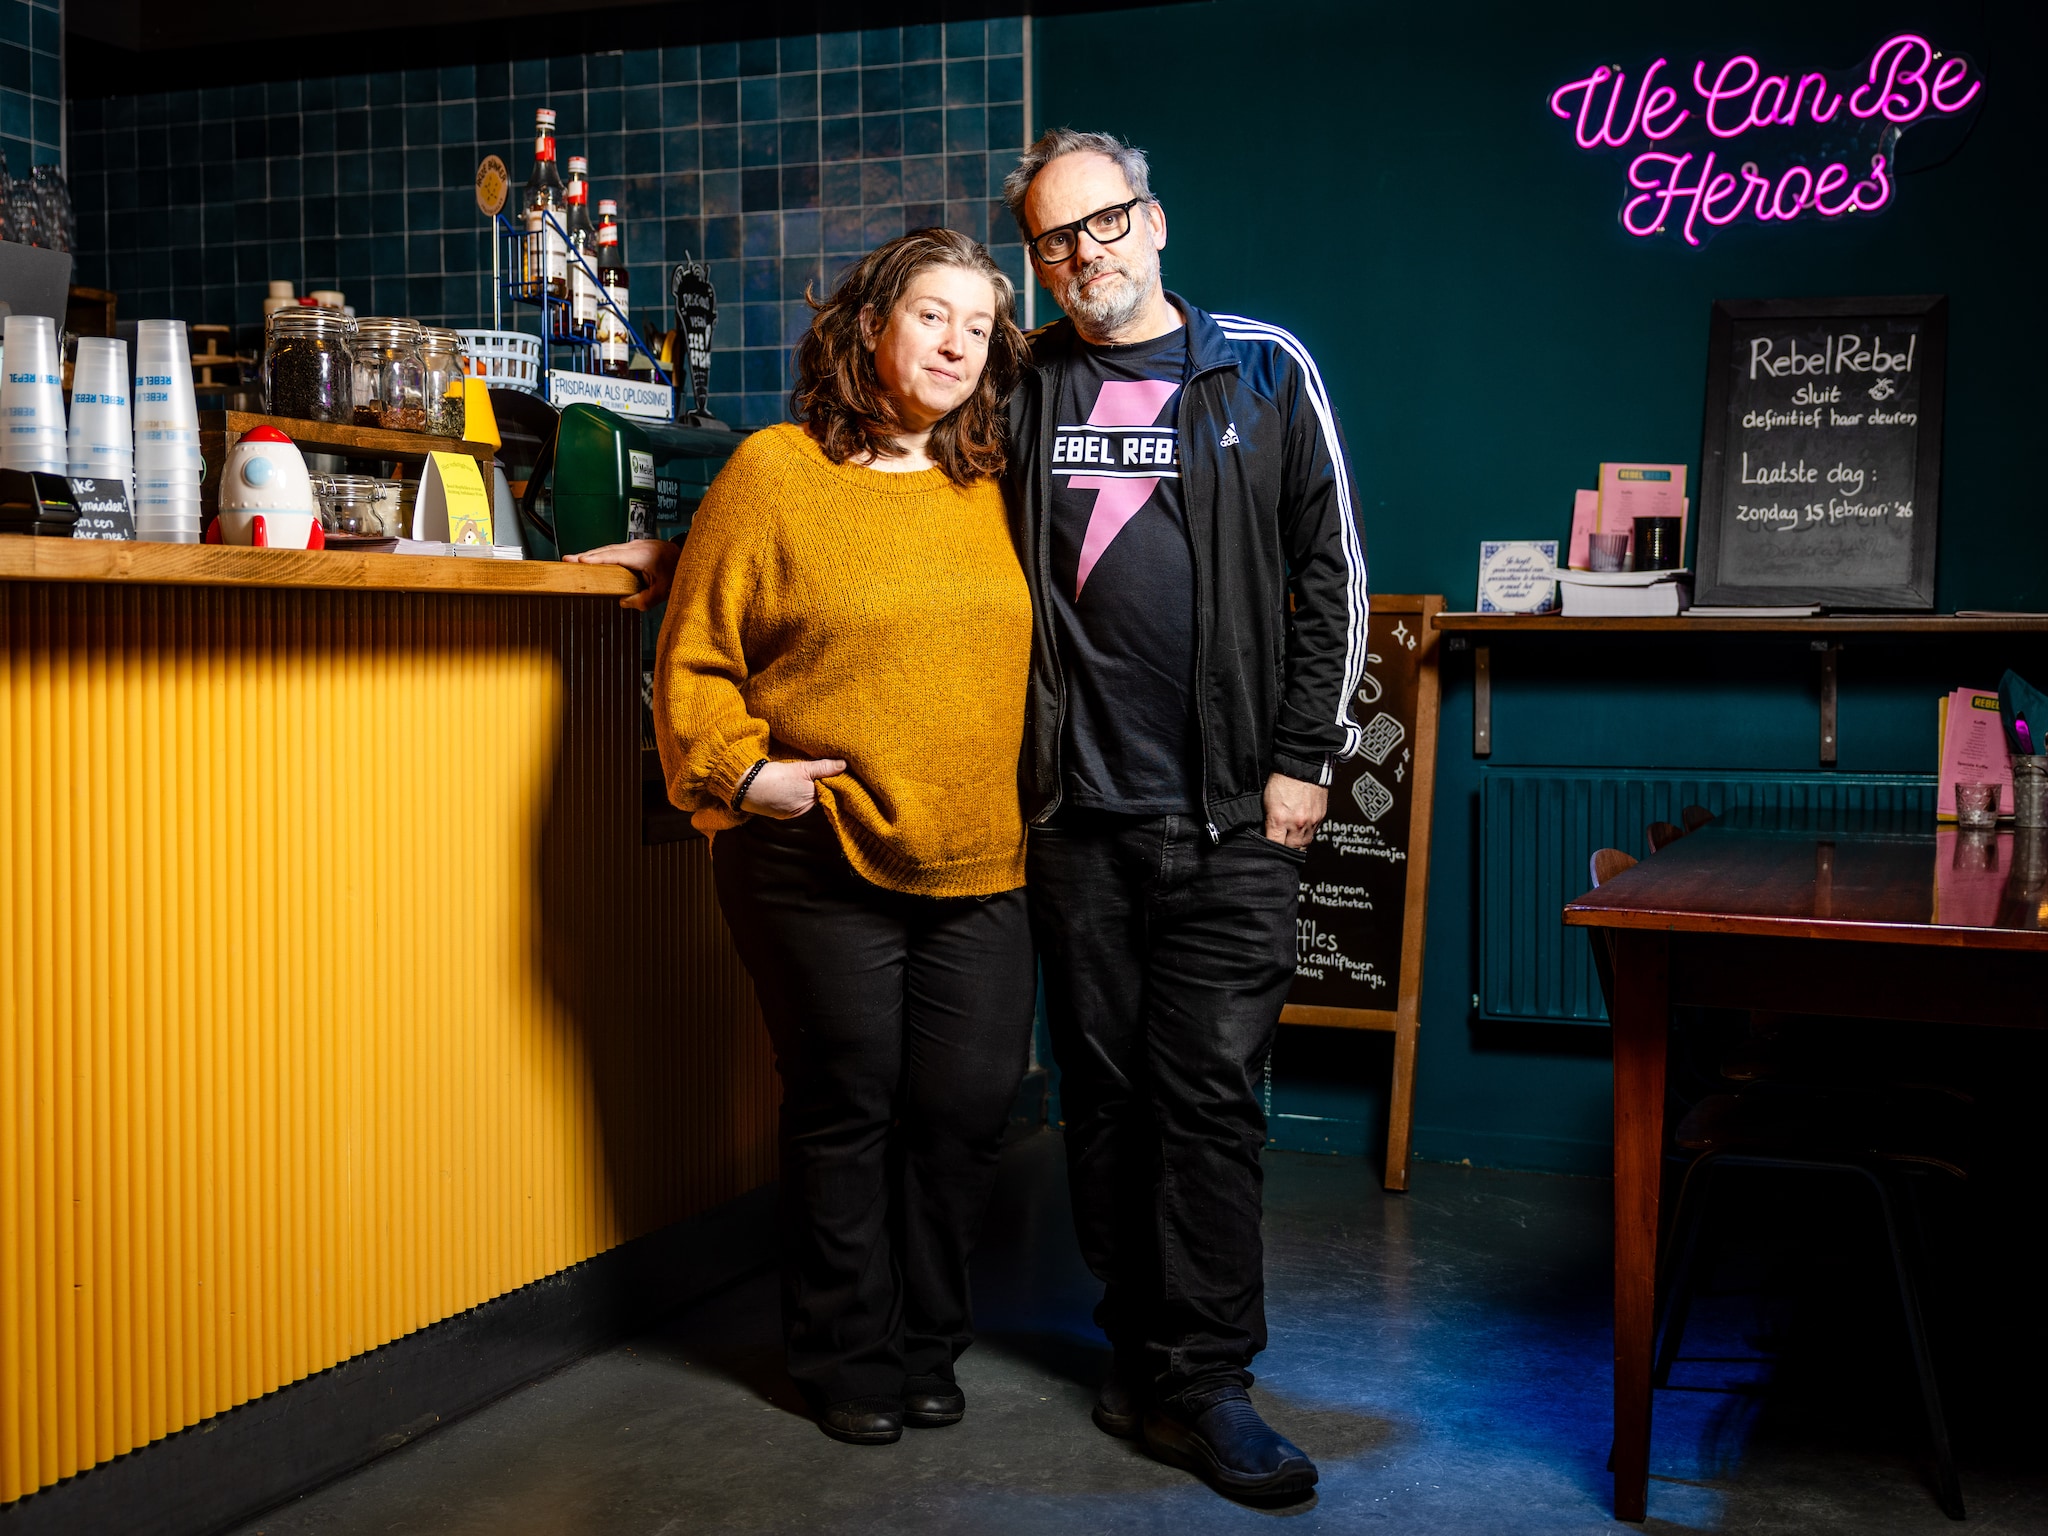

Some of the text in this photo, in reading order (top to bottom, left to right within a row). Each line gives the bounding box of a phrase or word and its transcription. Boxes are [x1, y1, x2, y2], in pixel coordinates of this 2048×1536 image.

[1551, 34, 1981, 149] We Can Be
[1622, 151, 1889, 247] Heroes
[145, 375, 172, 386] REBEL
[555, 378, 668, 407] FRISDRANK ALS OPLOSSING!
[1791, 382, 1841, 405] sluit
[1742, 408, 1917, 431] definitief haar deuren
[1052, 436, 1180, 466] EBEL REB
[1741, 452, 1818, 484] Laatste
[1804, 503, 1824, 522] 15
[1828, 498, 1888, 523] februari
[1322, 819, 1380, 836] slagroom,
[1340, 844, 1406, 863] pecannootjes
[1316, 882, 1370, 897] slagroom,
[1312, 893, 1373, 910] hazelnoten
[1296, 918, 1338, 952] ffles
[1309, 952, 1374, 972] cauliflower
[1351, 970, 1386, 990] wings,
